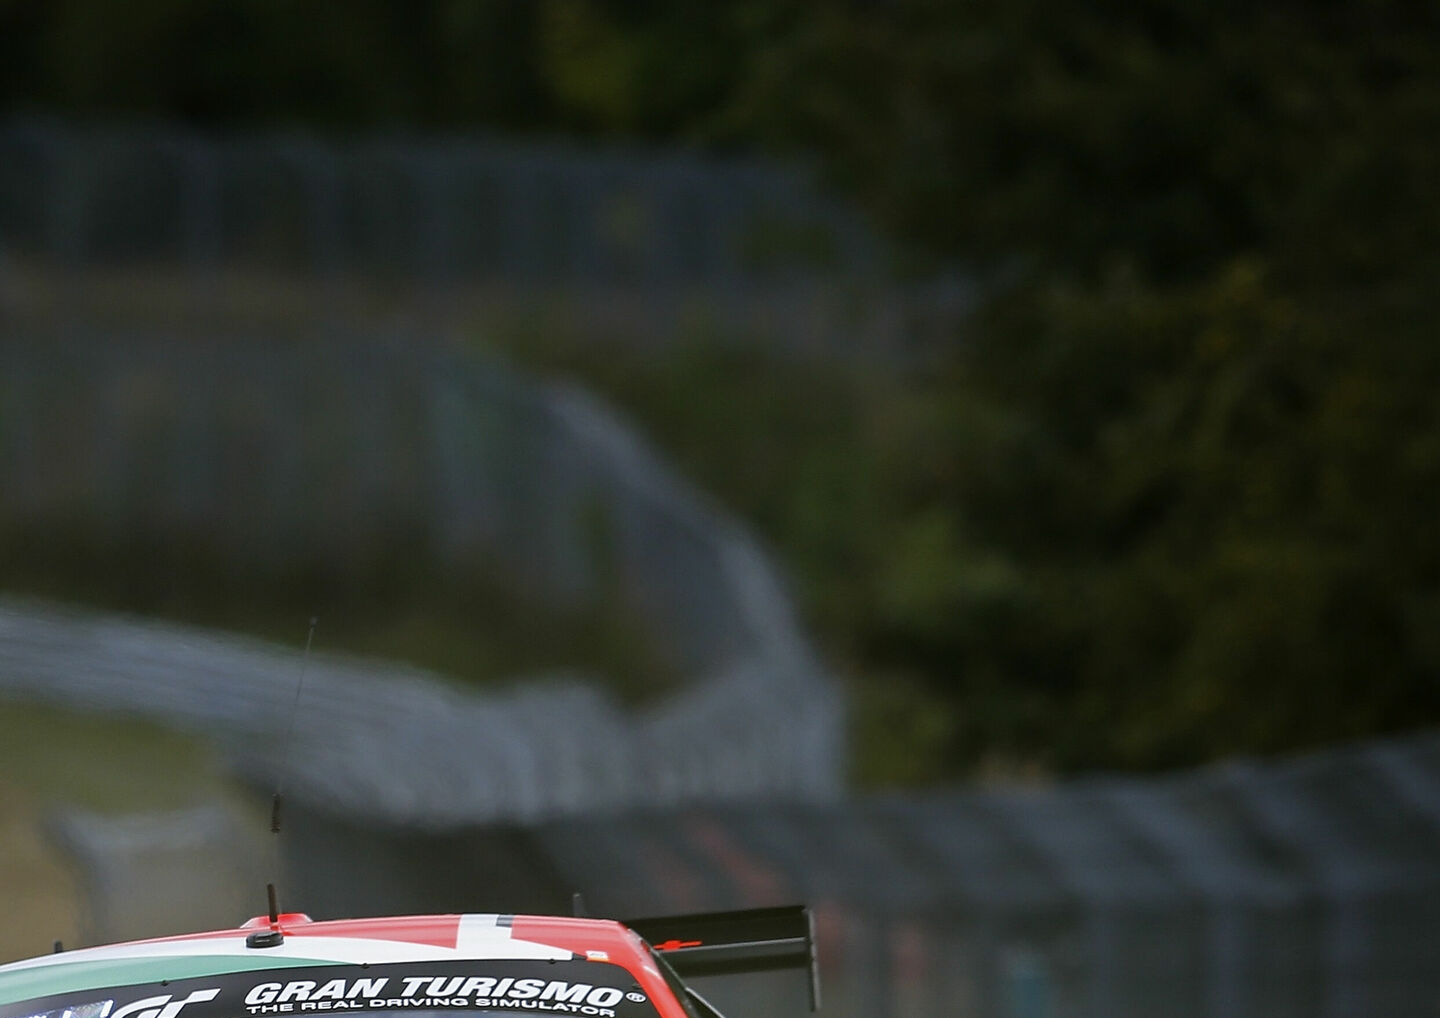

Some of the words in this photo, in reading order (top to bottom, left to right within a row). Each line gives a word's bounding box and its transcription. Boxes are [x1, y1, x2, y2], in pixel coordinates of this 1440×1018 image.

[245, 978, 389, 1006] GRAN
[245, 1004, 294, 1014] THE
[301, 1001, 364, 1011] REAL
[369, 998, 469, 1008] DRIVING
[475, 998, 616, 1018] SIMULATOR
